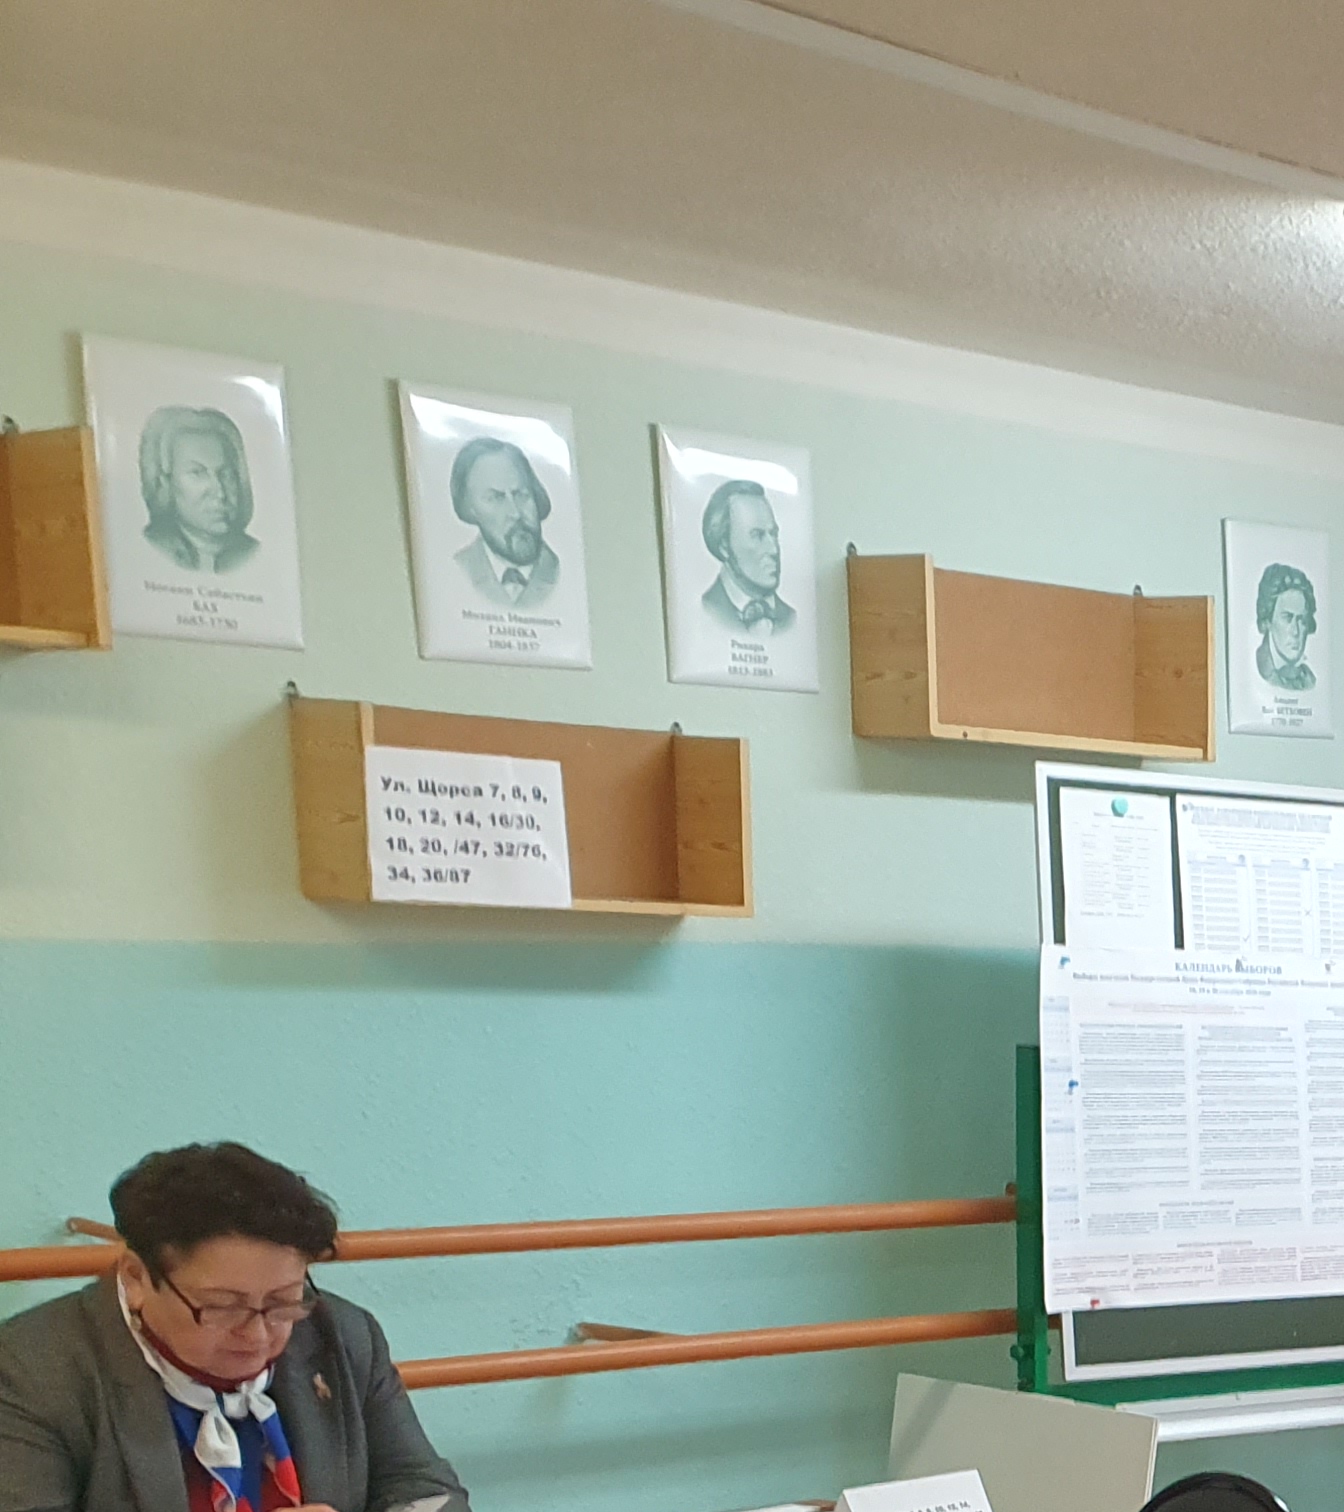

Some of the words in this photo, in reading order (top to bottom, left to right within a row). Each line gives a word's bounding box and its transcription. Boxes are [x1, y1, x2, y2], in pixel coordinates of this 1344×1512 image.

[381, 775, 411, 794] Ул.
[417, 778, 484, 799] Щорса
[489, 783, 506, 802] 7,
[511, 785, 528, 803] 8,
[532, 785, 548, 805] 9,
[384, 806, 412, 826] 10,
[418, 807, 447, 828] 12,
[454, 810, 482, 829] 14,
[488, 812, 541, 833] 16/30,
[385, 836, 415, 855] 18,
[419, 837, 449, 857] 20,
[386, 864, 417, 885] 34,
[1174, 962, 1233, 974] КАЛЕНДАРЬ
